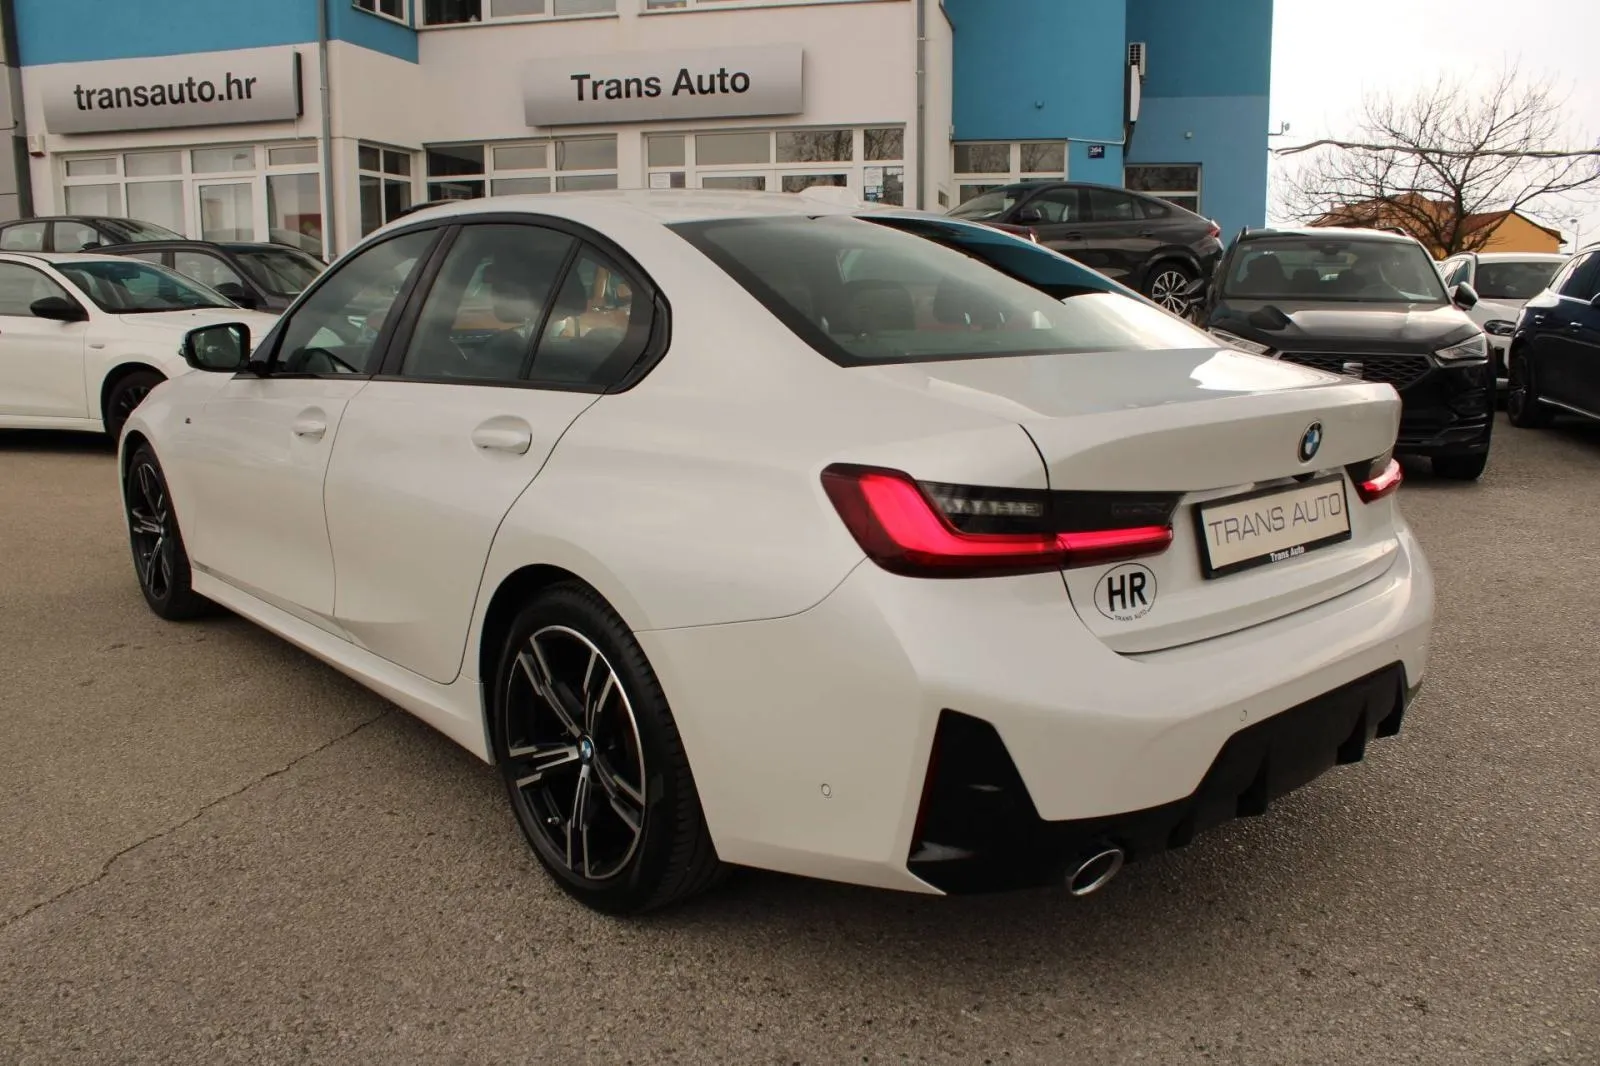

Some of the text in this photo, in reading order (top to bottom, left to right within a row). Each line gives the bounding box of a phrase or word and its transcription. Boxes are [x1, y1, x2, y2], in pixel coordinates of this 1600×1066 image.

[73, 72, 257, 111] transauto.hr
[570, 68, 751, 102] Trans Auto
[1208, 492, 1342, 546] TRANS AUTO
[1269, 545, 1305, 562] Trans Auto
[1107, 571, 1148, 612] HR
[1114, 609, 1148, 622] TRANS AUTO
